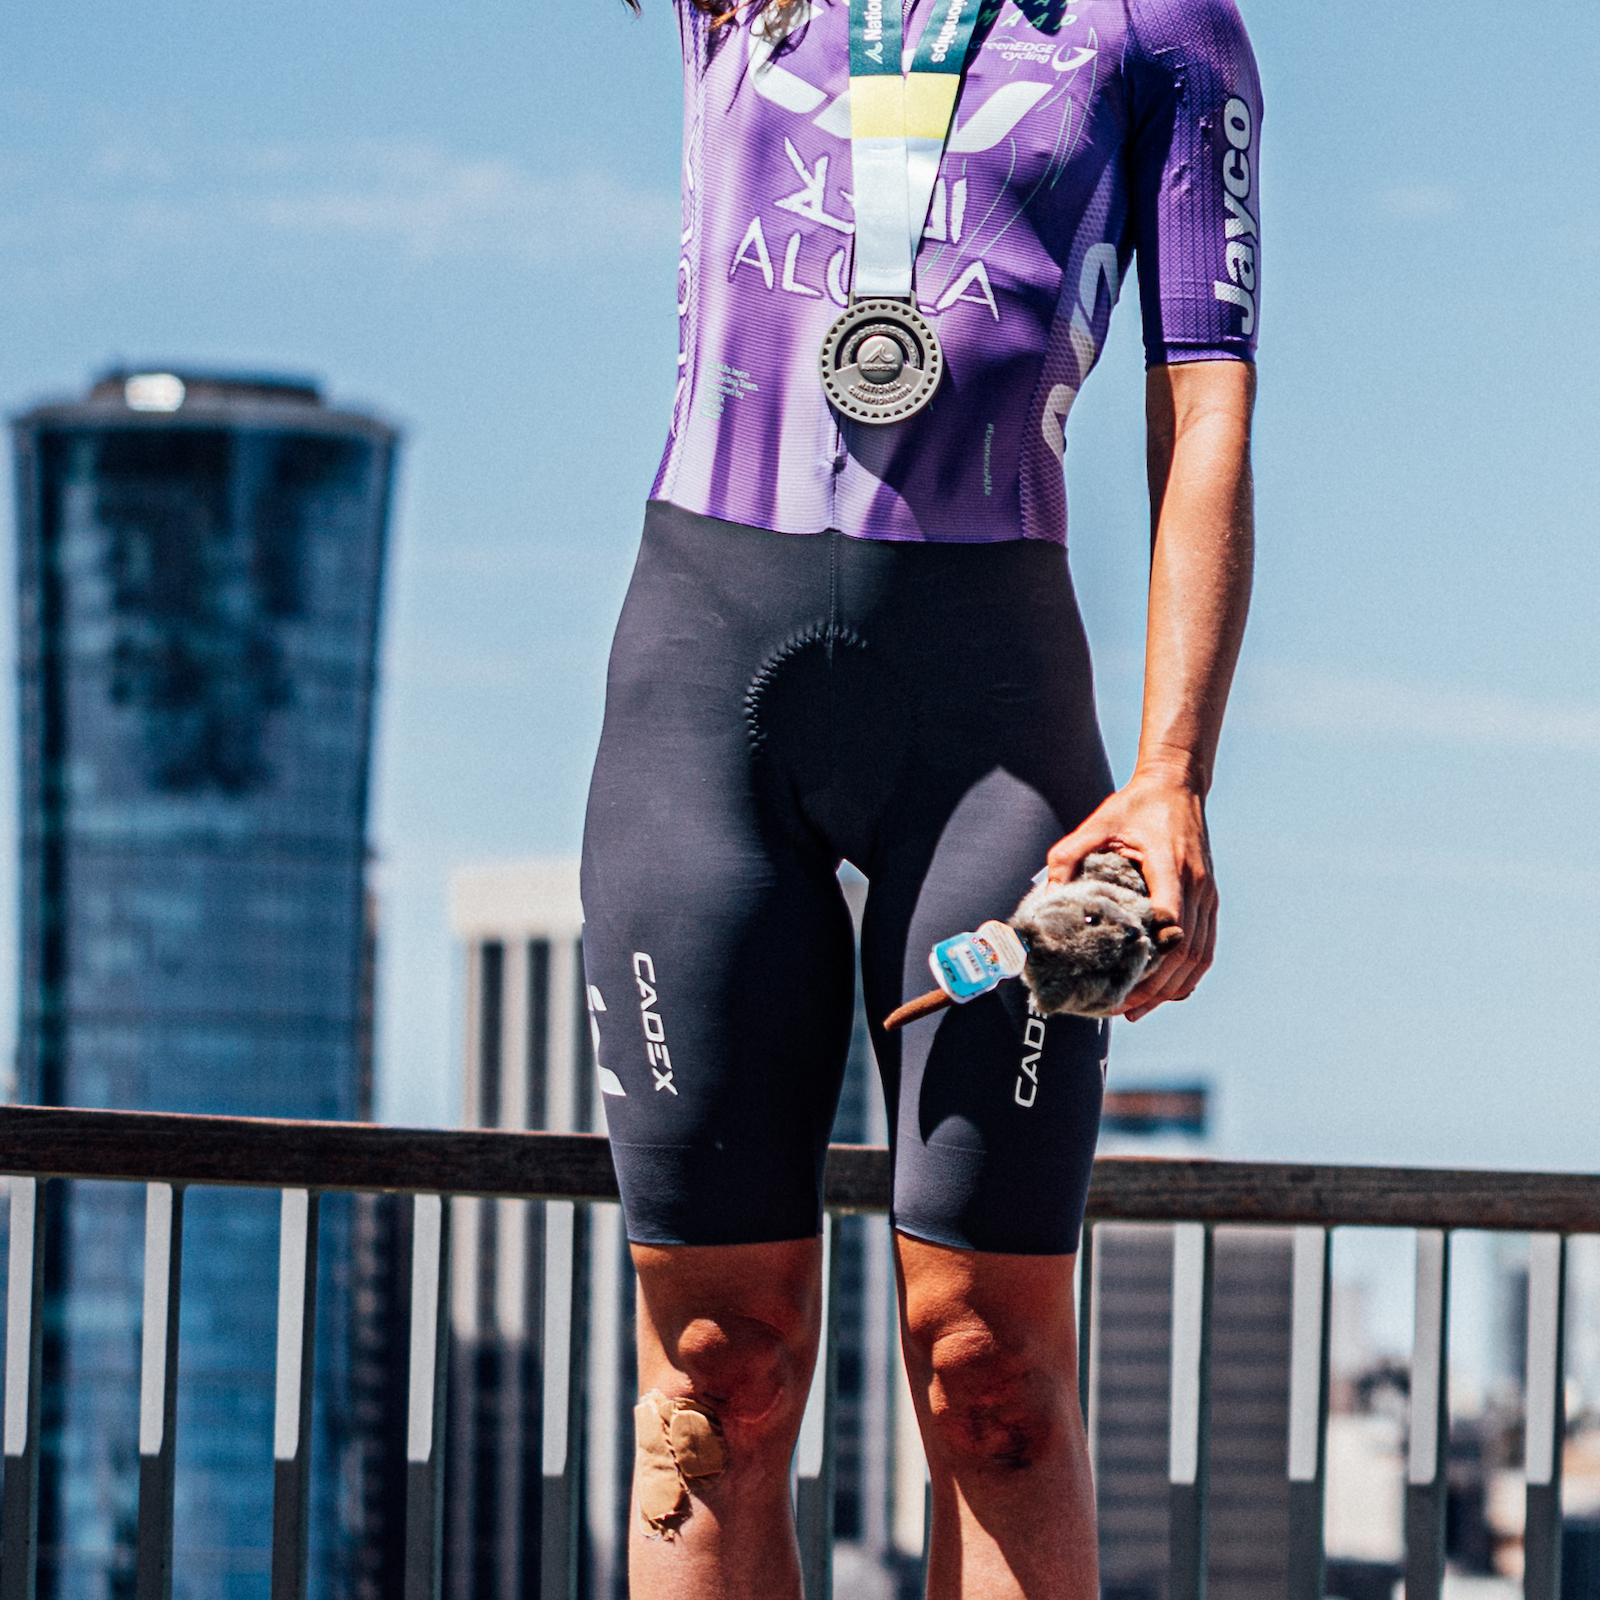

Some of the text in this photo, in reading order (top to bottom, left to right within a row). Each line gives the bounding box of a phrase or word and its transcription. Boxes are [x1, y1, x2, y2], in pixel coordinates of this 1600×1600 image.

[975, 8, 1078, 30] MAAP
[1001, 51, 1051, 64] cycling
[1213, 98, 1258, 336] Jayco
[632, 951, 678, 1095] CADEX
